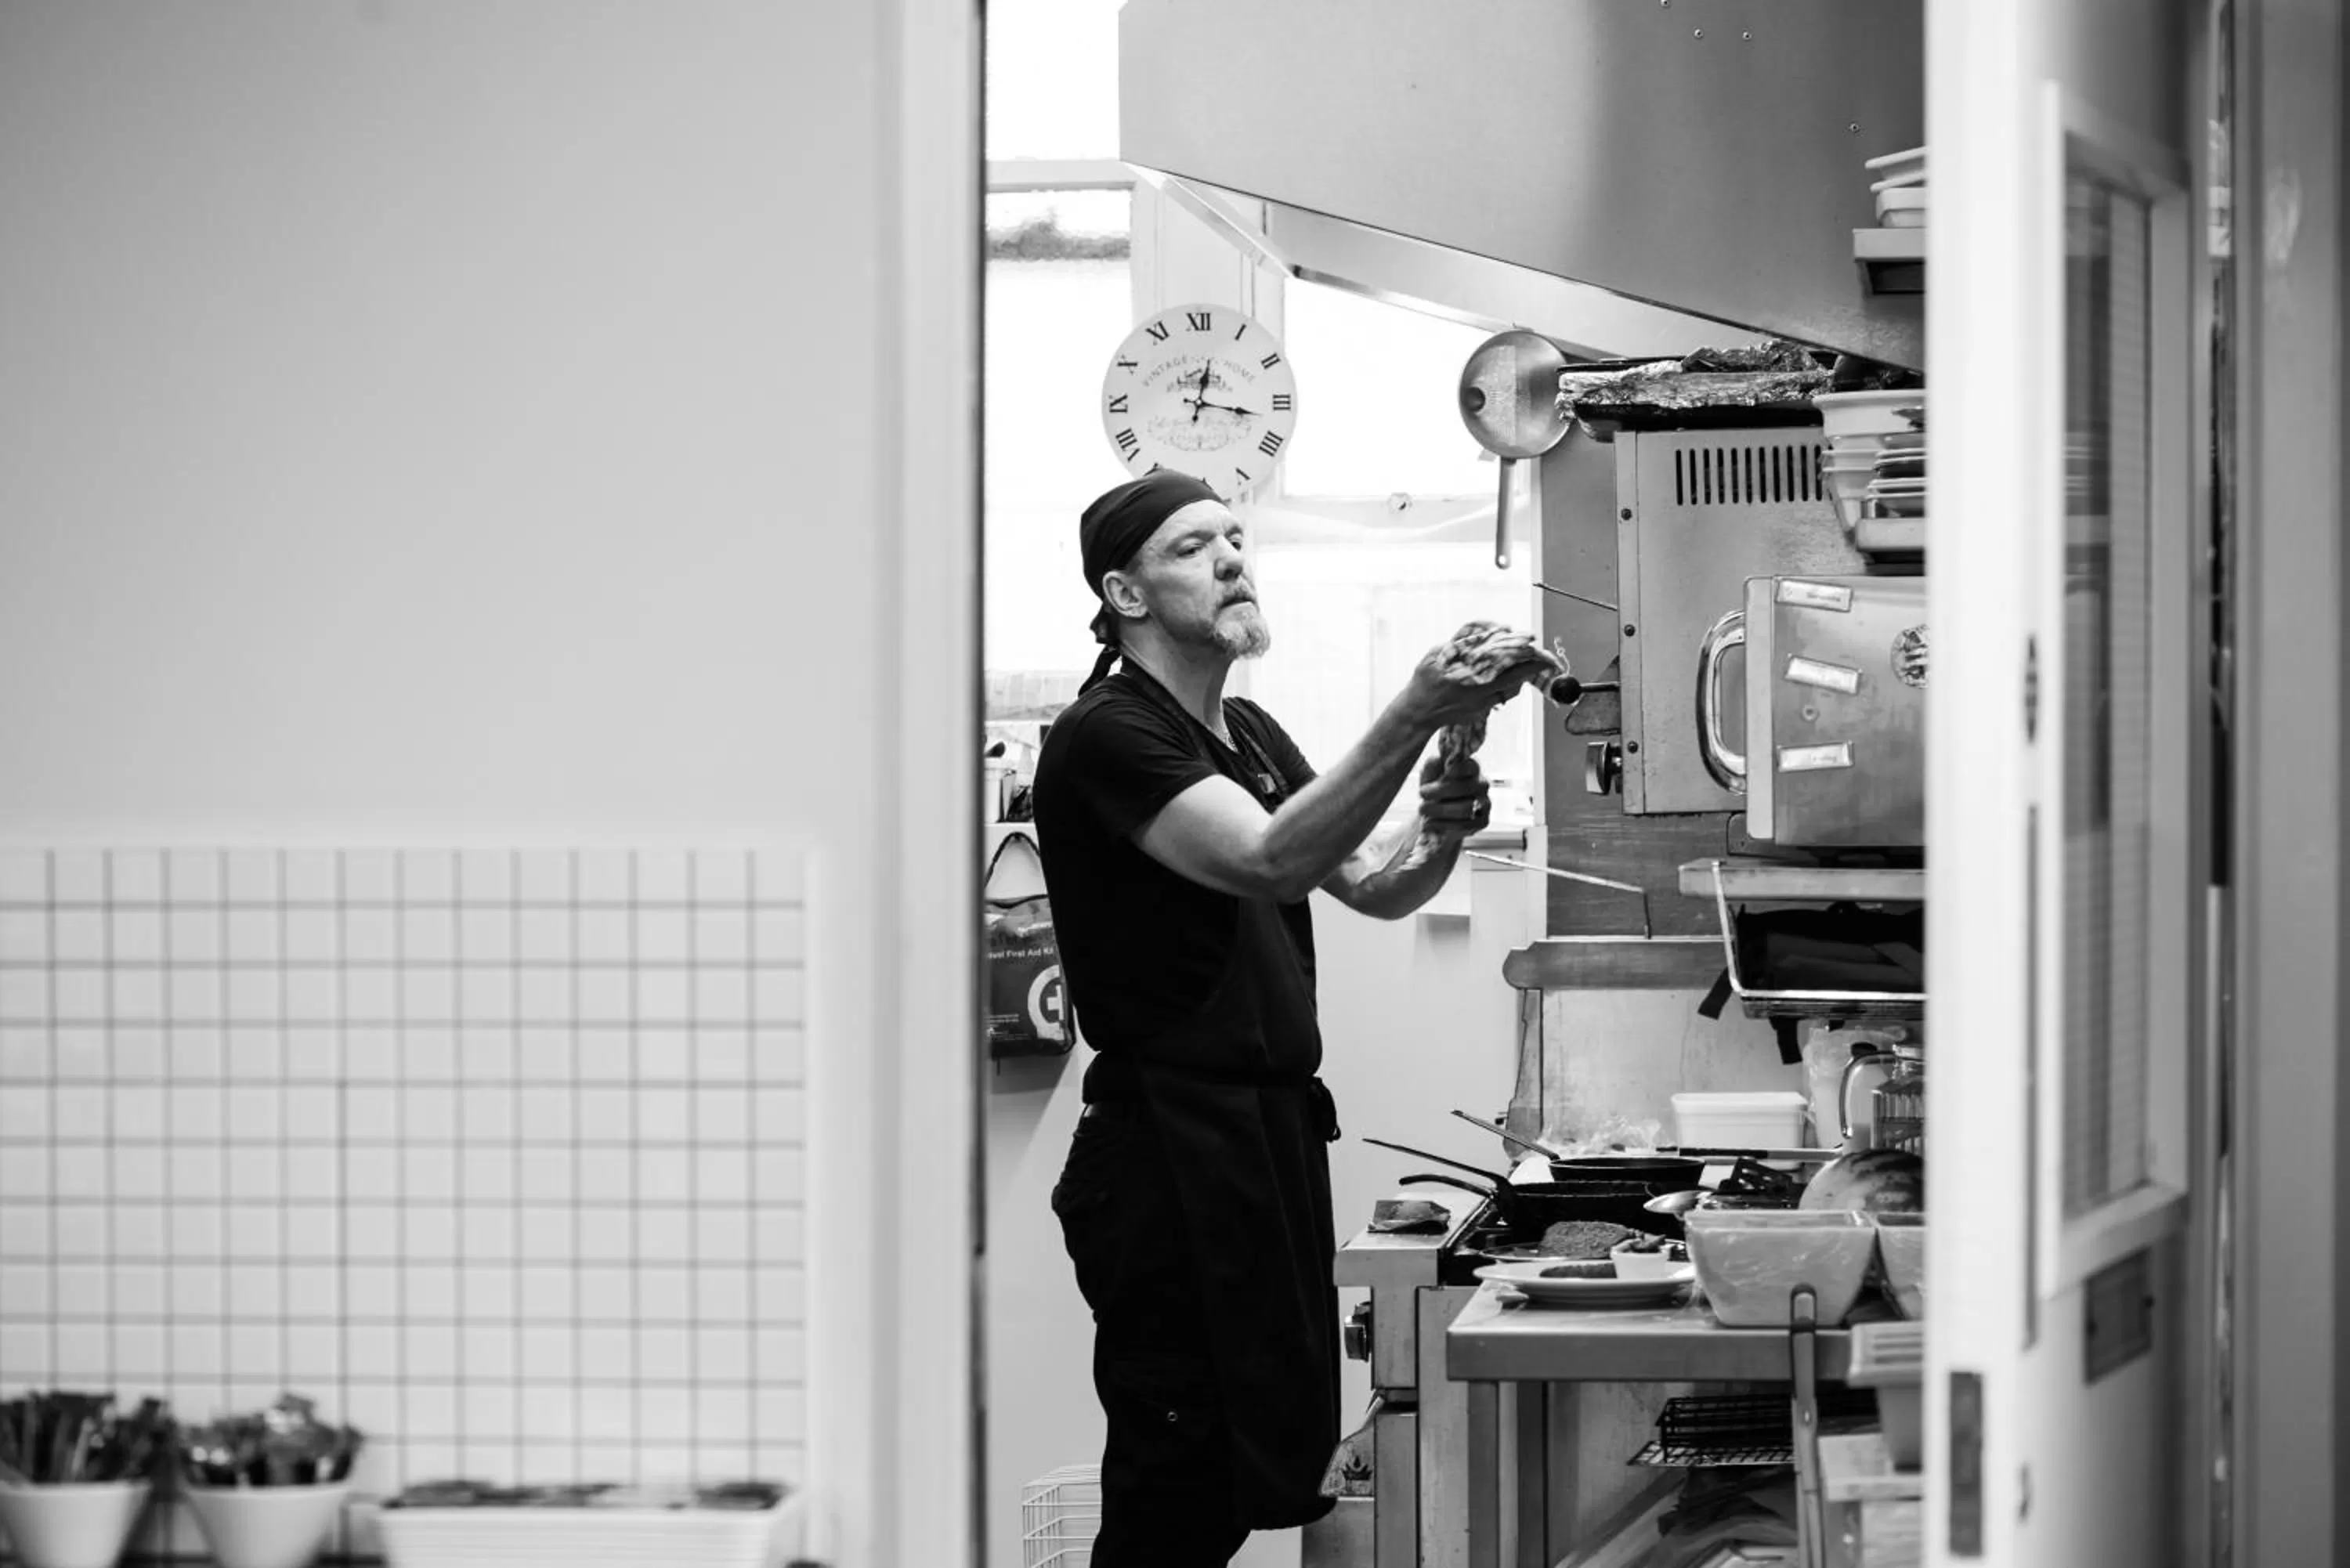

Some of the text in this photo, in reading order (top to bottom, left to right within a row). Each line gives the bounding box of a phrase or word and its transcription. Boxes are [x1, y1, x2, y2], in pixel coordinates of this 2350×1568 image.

[1186, 313, 1211, 331] XII
[1145, 321, 1170, 345] XI
[1235, 323, 1247, 341] I
[1116, 354, 1138, 376] X
[1260, 352, 1281, 370] II
[1108, 395, 1128, 414] IX
[1272, 394, 1291, 411] III
[1115, 428, 1141, 462] VIII
[1258, 431, 1284, 457] IIII
[1006, 948, 1025, 959] First
[1027, 947, 1041, 957] Aid
